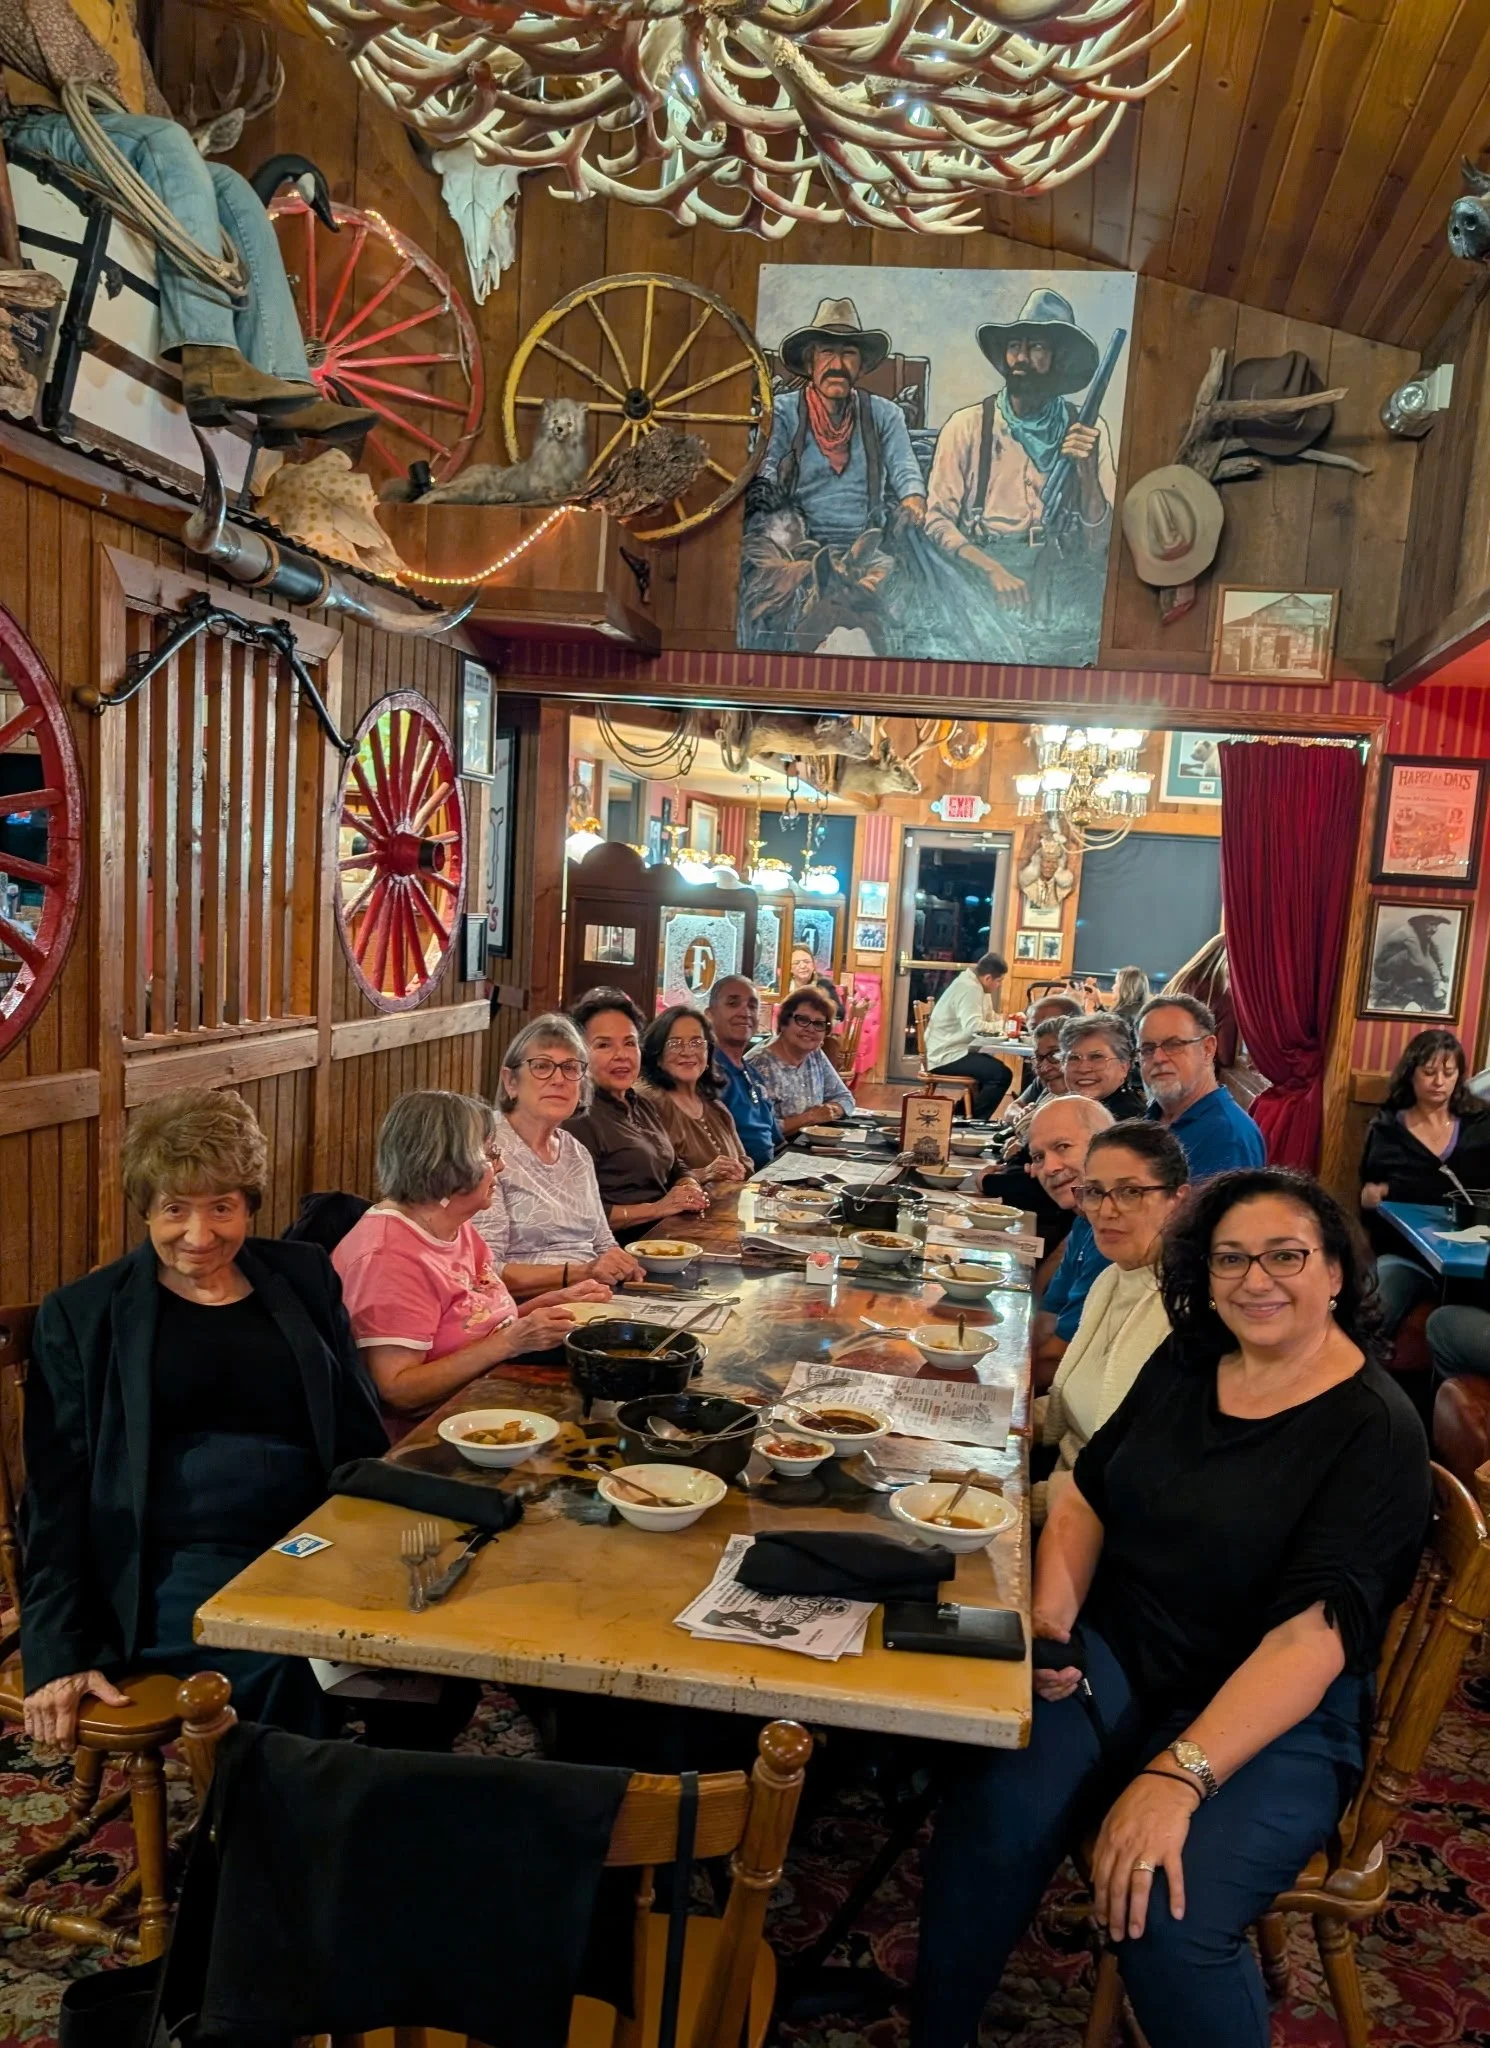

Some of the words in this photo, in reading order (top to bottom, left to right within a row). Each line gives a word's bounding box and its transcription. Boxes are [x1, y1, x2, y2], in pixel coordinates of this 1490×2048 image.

[1398, 770, 1433, 786] HAPPY
[1443, 772, 1472, 791] DAYS
[949, 797, 975, 818] EXIT
[691, 945, 713, 990] F
